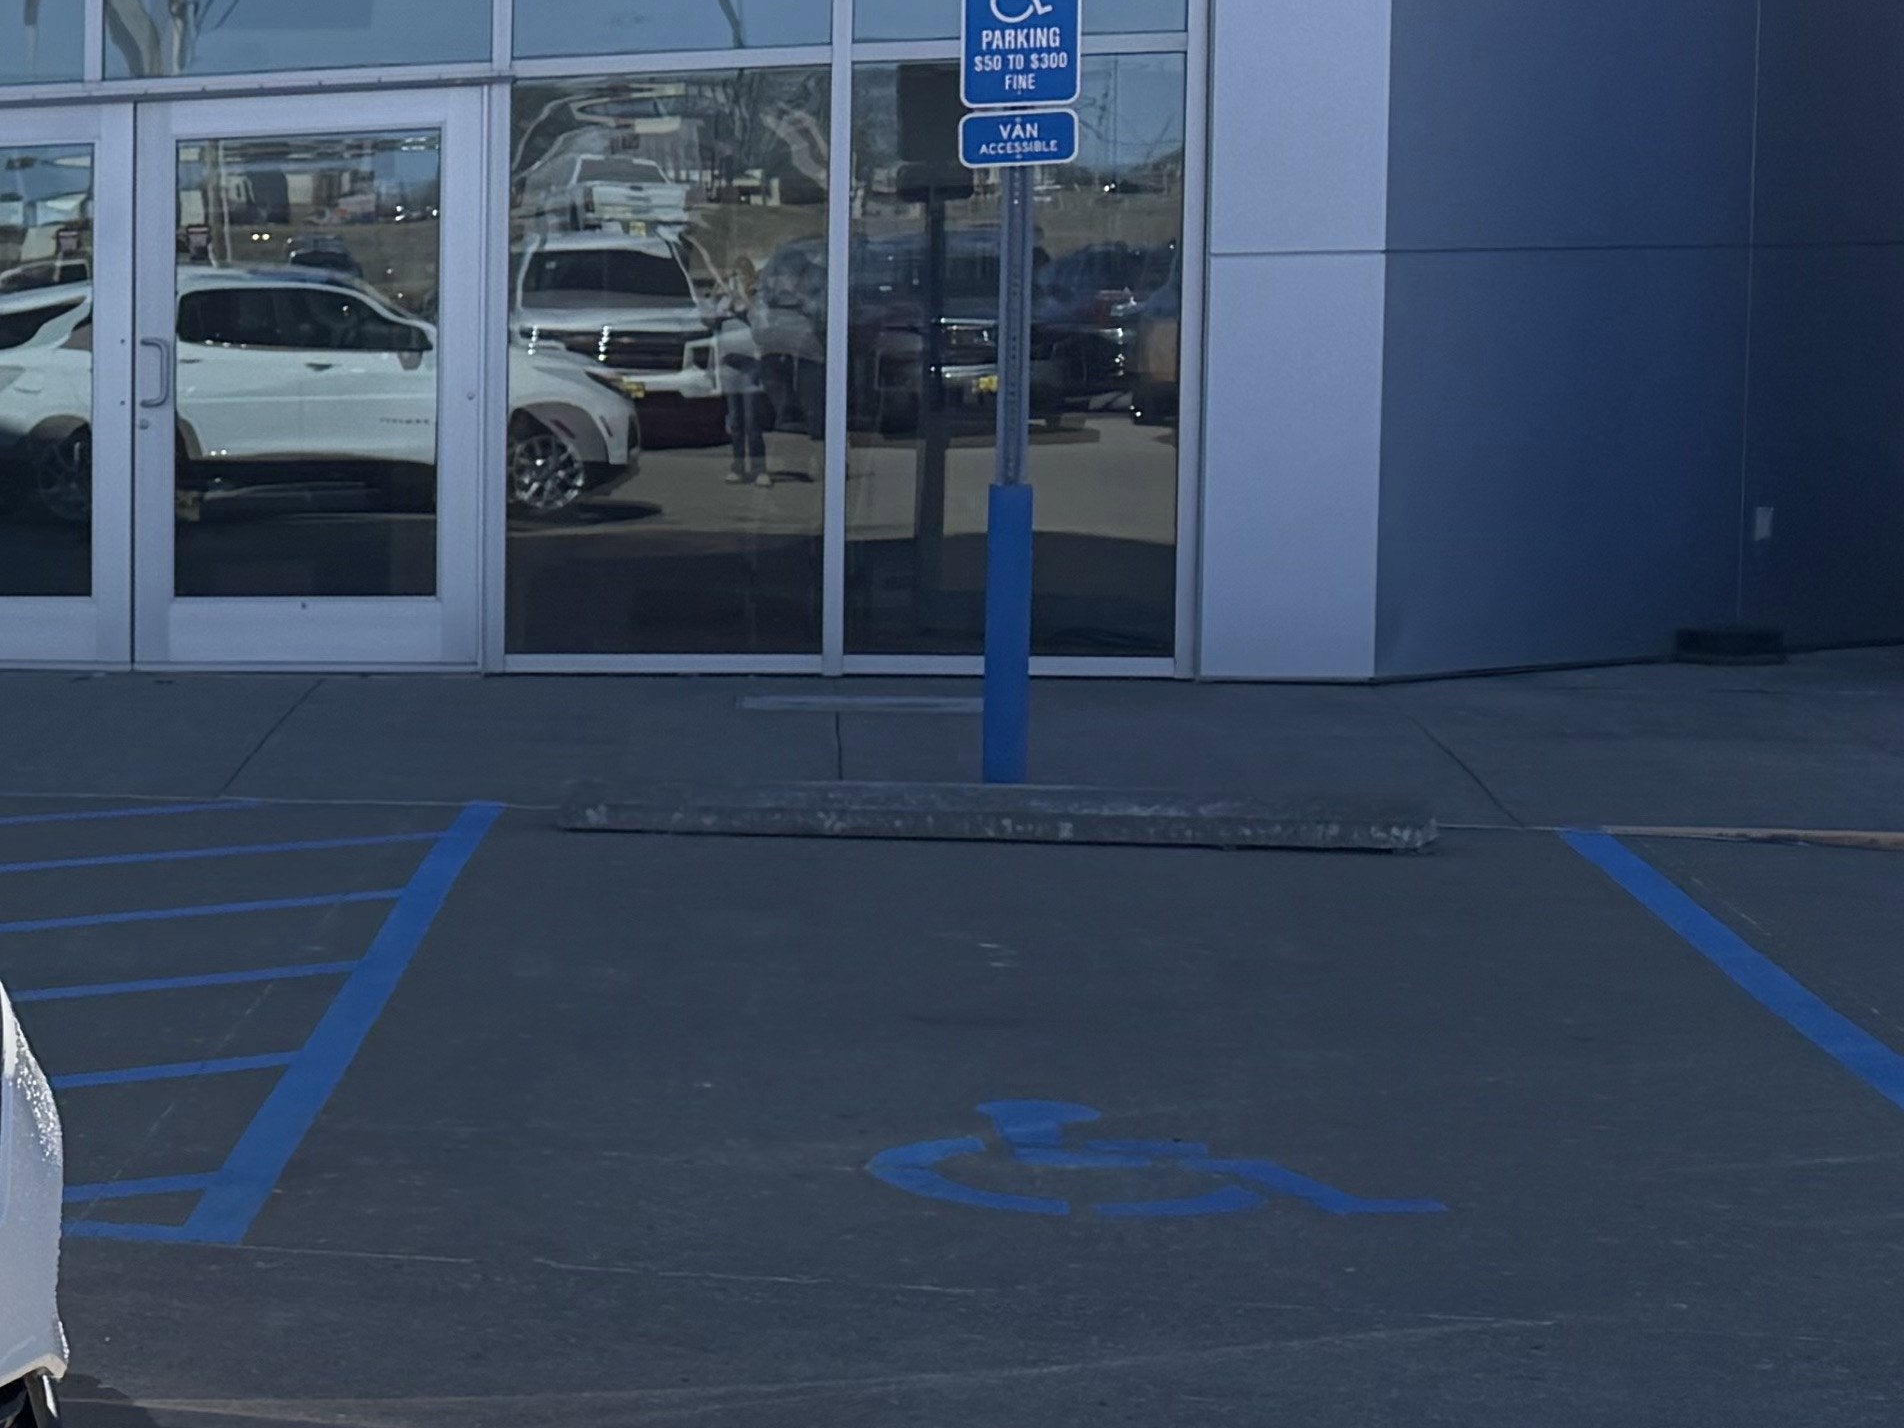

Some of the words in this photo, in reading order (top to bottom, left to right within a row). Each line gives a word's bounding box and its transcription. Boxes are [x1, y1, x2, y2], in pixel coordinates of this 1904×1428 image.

[981, 27, 1061, 51] PARKING
[974, 55, 1002, 72] $50
[1007, 54, 1025, 70] TO
[1030, 52, 1068, 70] $300
[1004, 73, 1036, 90] FINE
[999, 123, 1038, 140] VAN
[979, 139, 1058, 155] ACCESSIBLE
